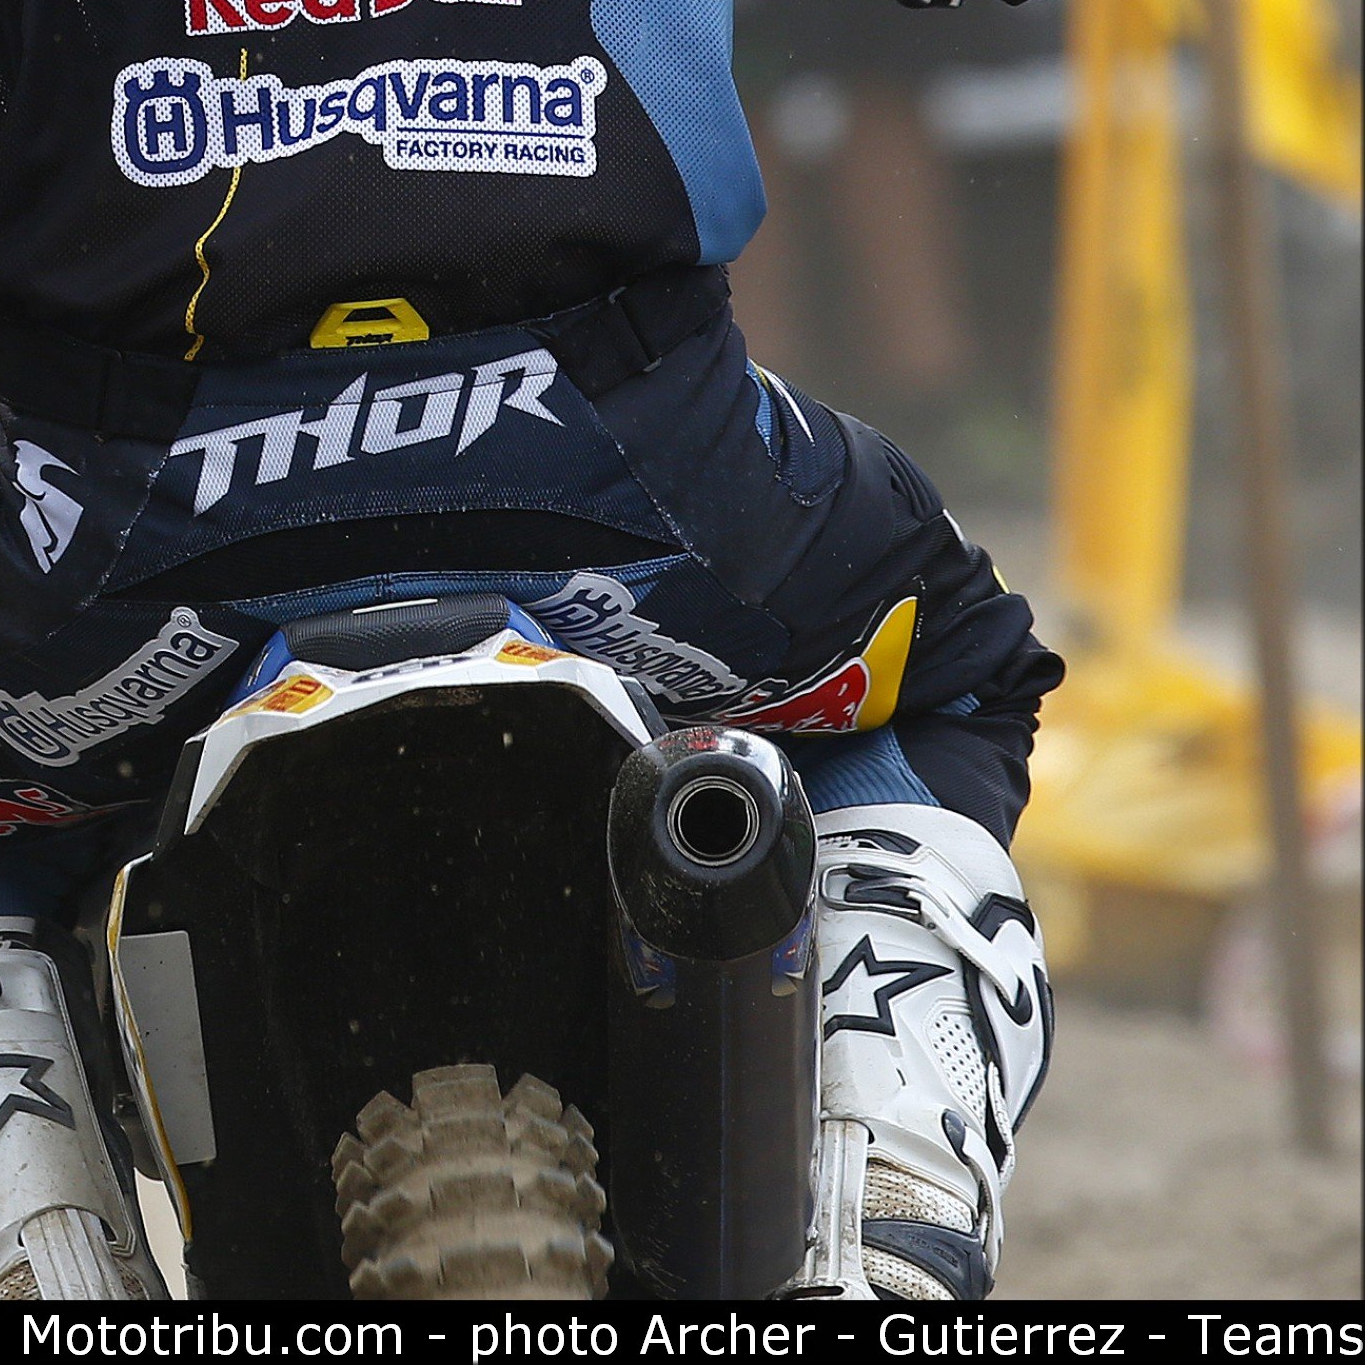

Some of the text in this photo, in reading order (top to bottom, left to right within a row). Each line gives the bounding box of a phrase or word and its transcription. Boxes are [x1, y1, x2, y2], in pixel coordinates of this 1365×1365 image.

[220, 71, 584, 156] Husqvarna
[396, 139, 586, 166] FACTORY RACING
[169, 347, 567, 517] THOR
[27, 631, 222, 745] Husqvarna
